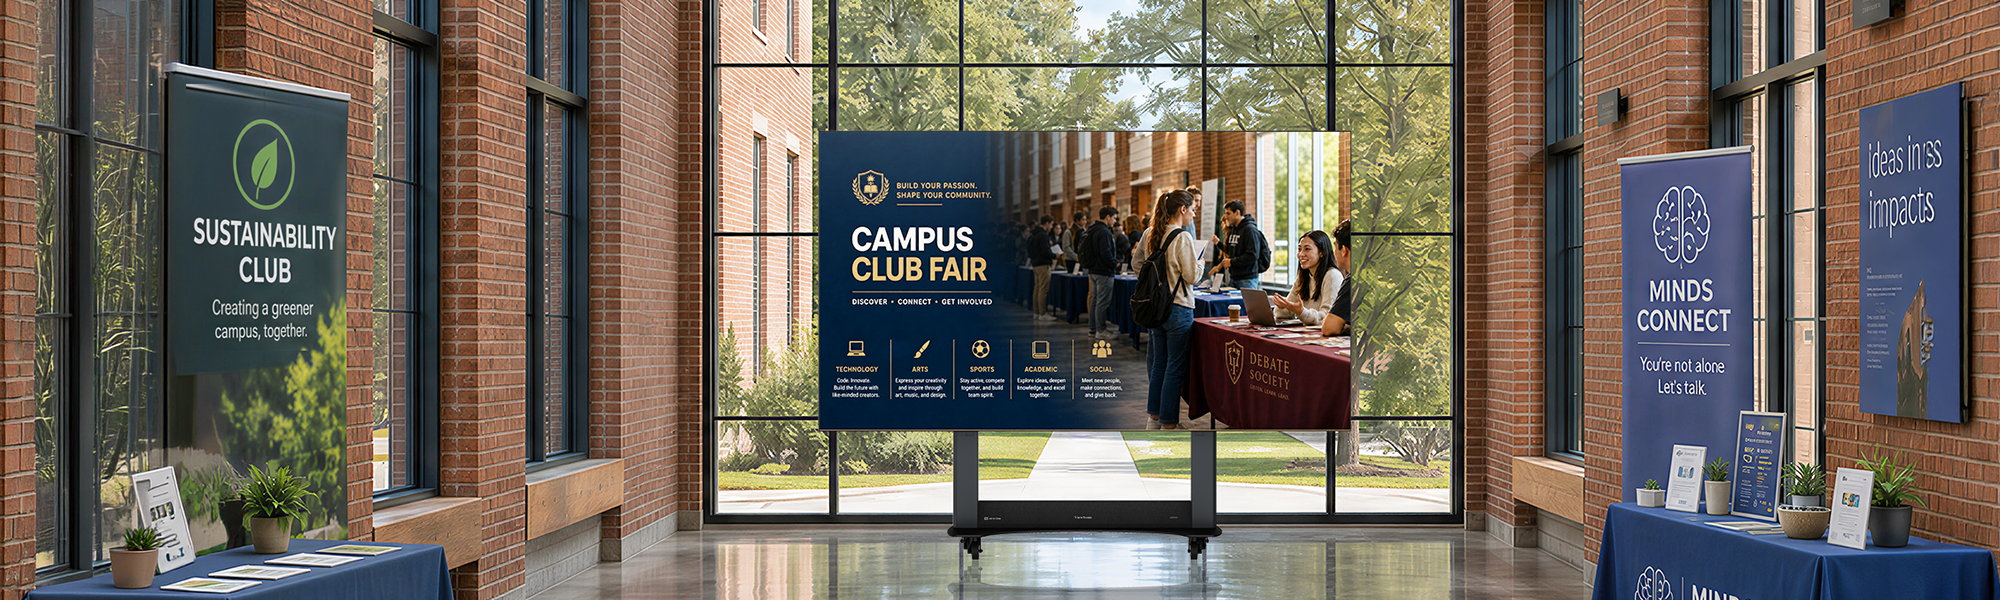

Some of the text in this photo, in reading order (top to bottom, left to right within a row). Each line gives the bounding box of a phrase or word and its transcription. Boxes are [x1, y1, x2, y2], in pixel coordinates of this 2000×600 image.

[896, 182, 978, 190] BUILD YOUR PASSION.
[896, 191, 992, 199] SHAPE YOUR COMMUNITY.
[193, 217, 337, 250] SUSTAINABILITY
[851, 226, 974, 252] CAMPUS
[239, 256, 292, 283] CLUB
[851, 256, 988, 282] CLUB FAIR
[1649, 278, 1714, 302] MINDS
[212, 298, 314, 320] Creating a greener
[852, 298, 993, 306] DISCOVER CONNECT GET INVOLVED
[1637, 308, 1731, 332] CONNECT
[214, 322, 308, 342] campus, together.
[1250, 351, 1290, 375] DEBATE
[1674, 358, 1693, 373] not
[1695, 358, 1725, 374] alone
[1250, 369, 1290, 390] SOCIETY
[1658, 379, 1682, 395] Let's
